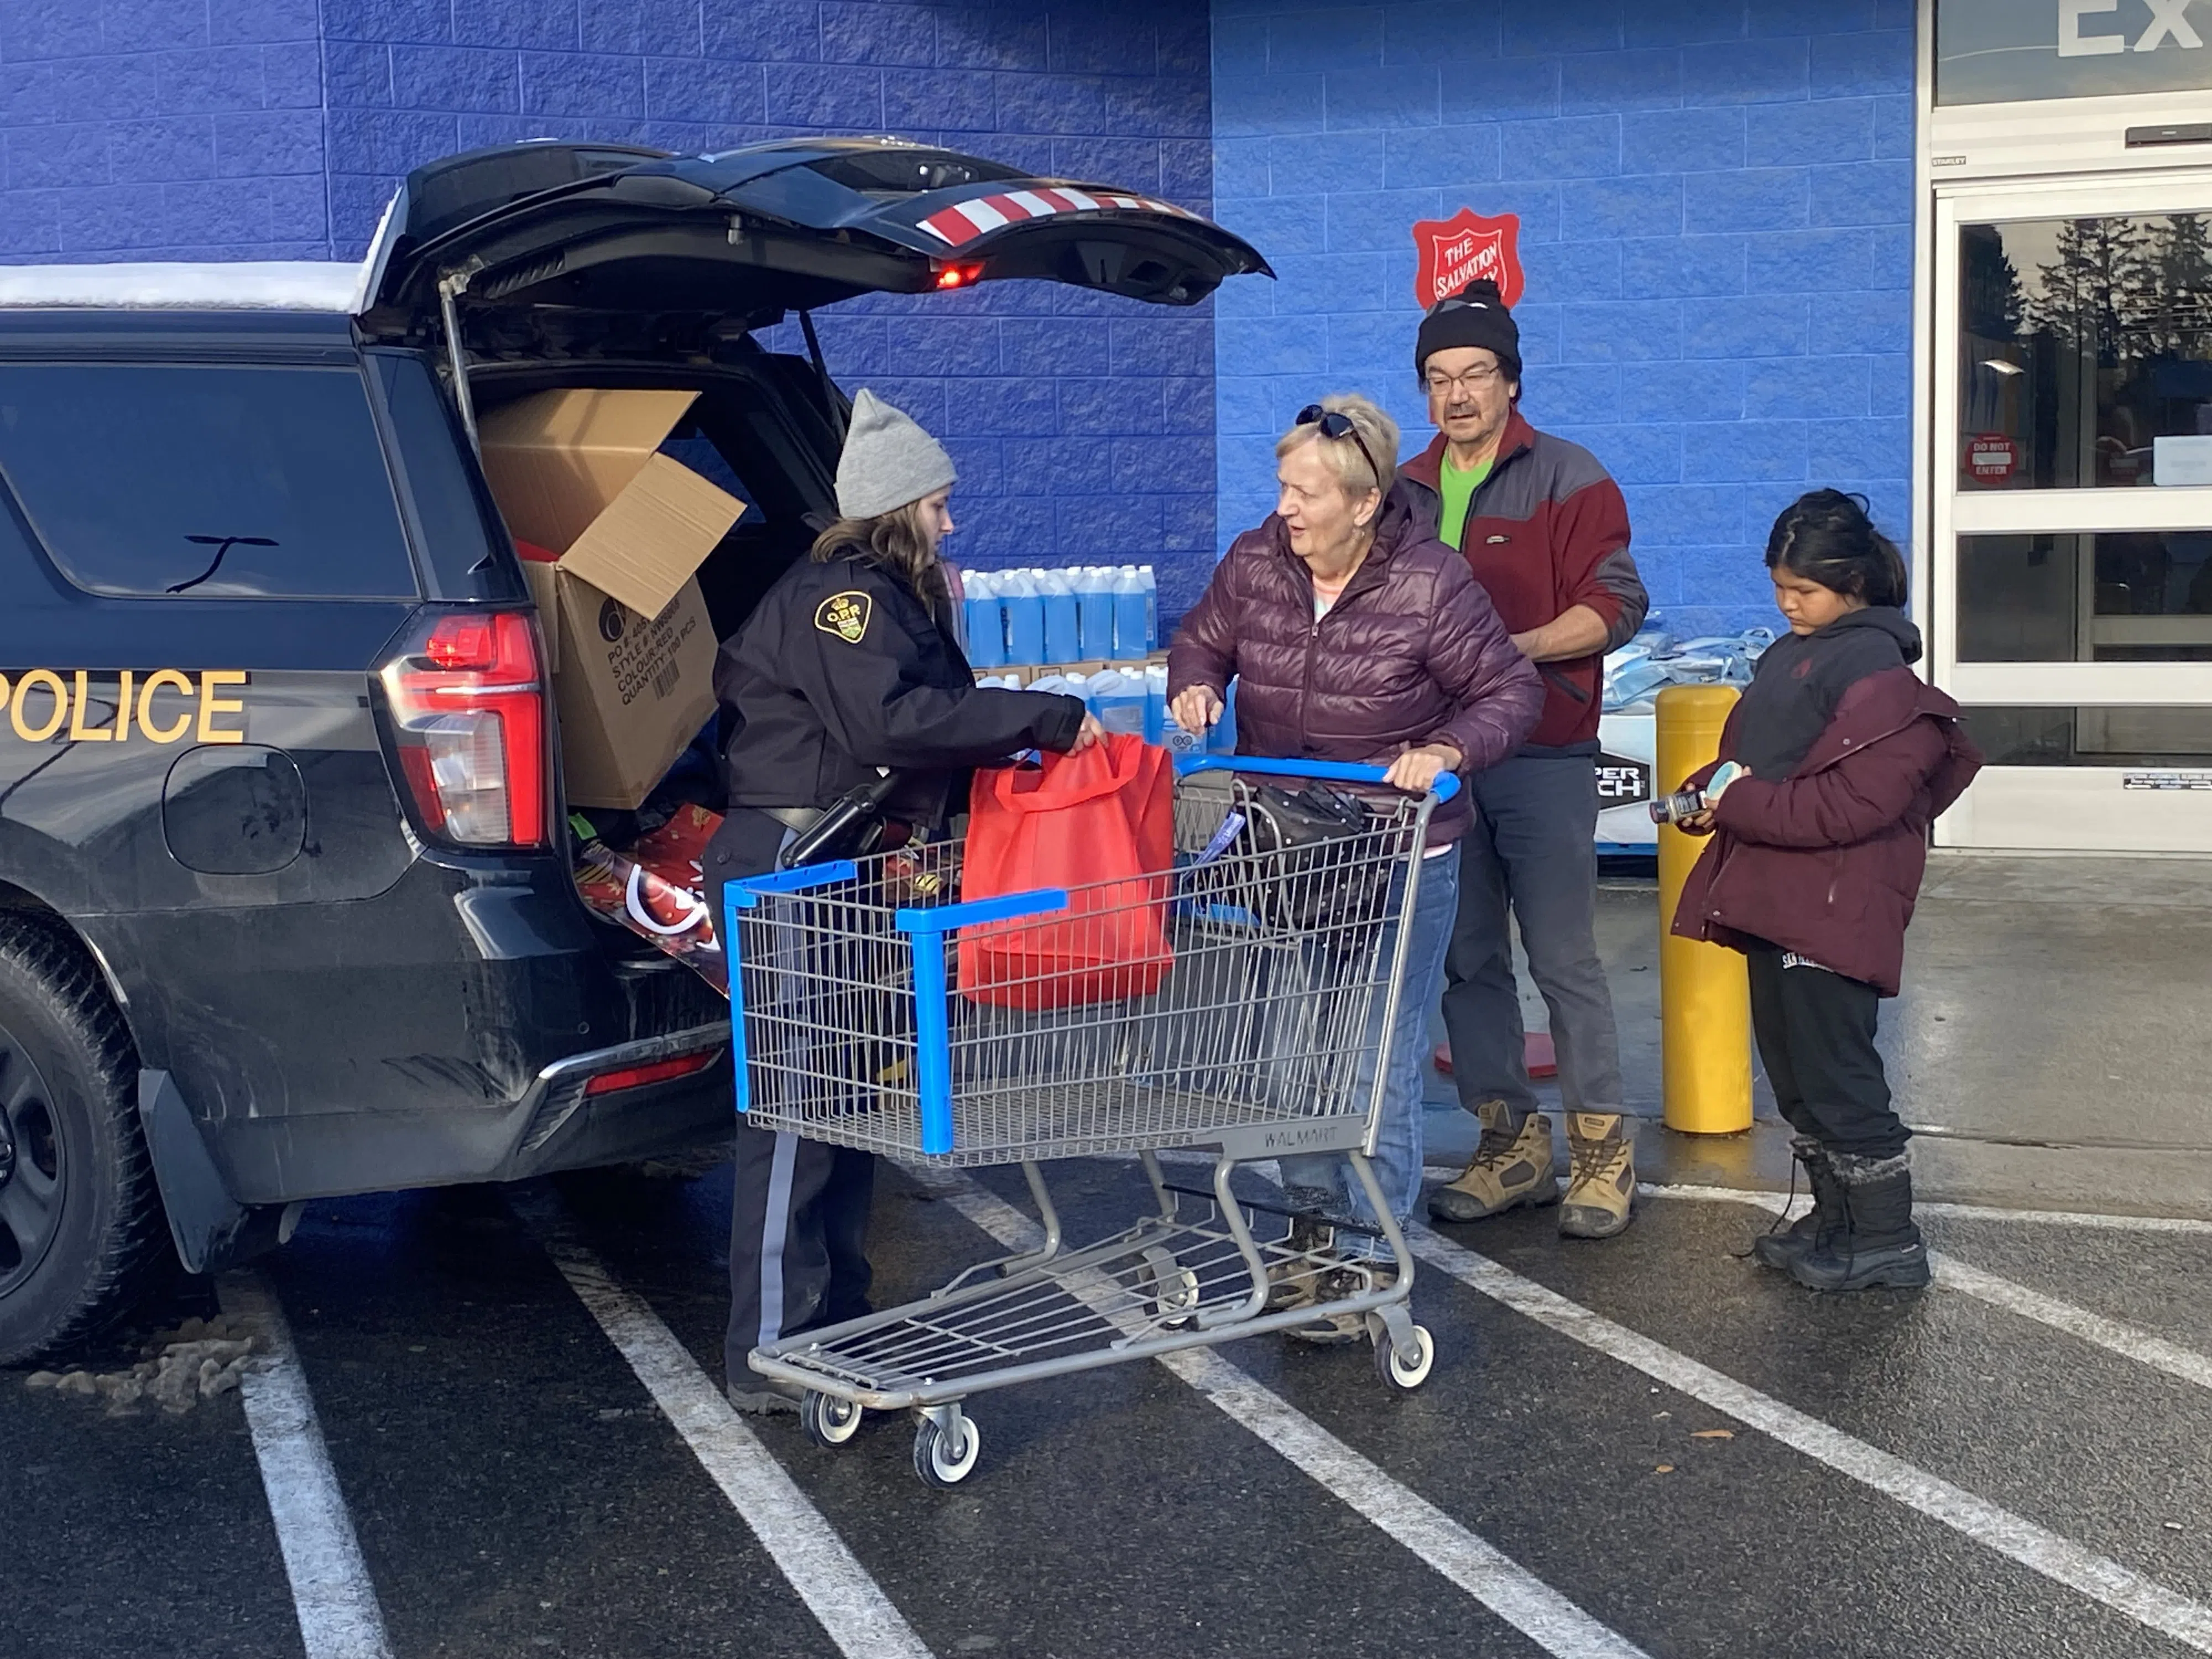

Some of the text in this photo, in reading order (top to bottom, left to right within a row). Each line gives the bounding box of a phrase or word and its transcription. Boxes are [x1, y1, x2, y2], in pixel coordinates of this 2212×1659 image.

[1444, 237, 1473, 267] THE
[1437, 241, 1497, 298] SALVATION
[1973, 442, 2010, 451] DO NOT
[1976, 465, 2007, 474] ENTER
[680, 615, 696, 641] PCS
[608, 645, 622, 664] PO
[612, 642, 643, 679] STYLE
[0, 669, 247, 743] OLICE
[1265, 1126, 1338, 1147] WALMART
